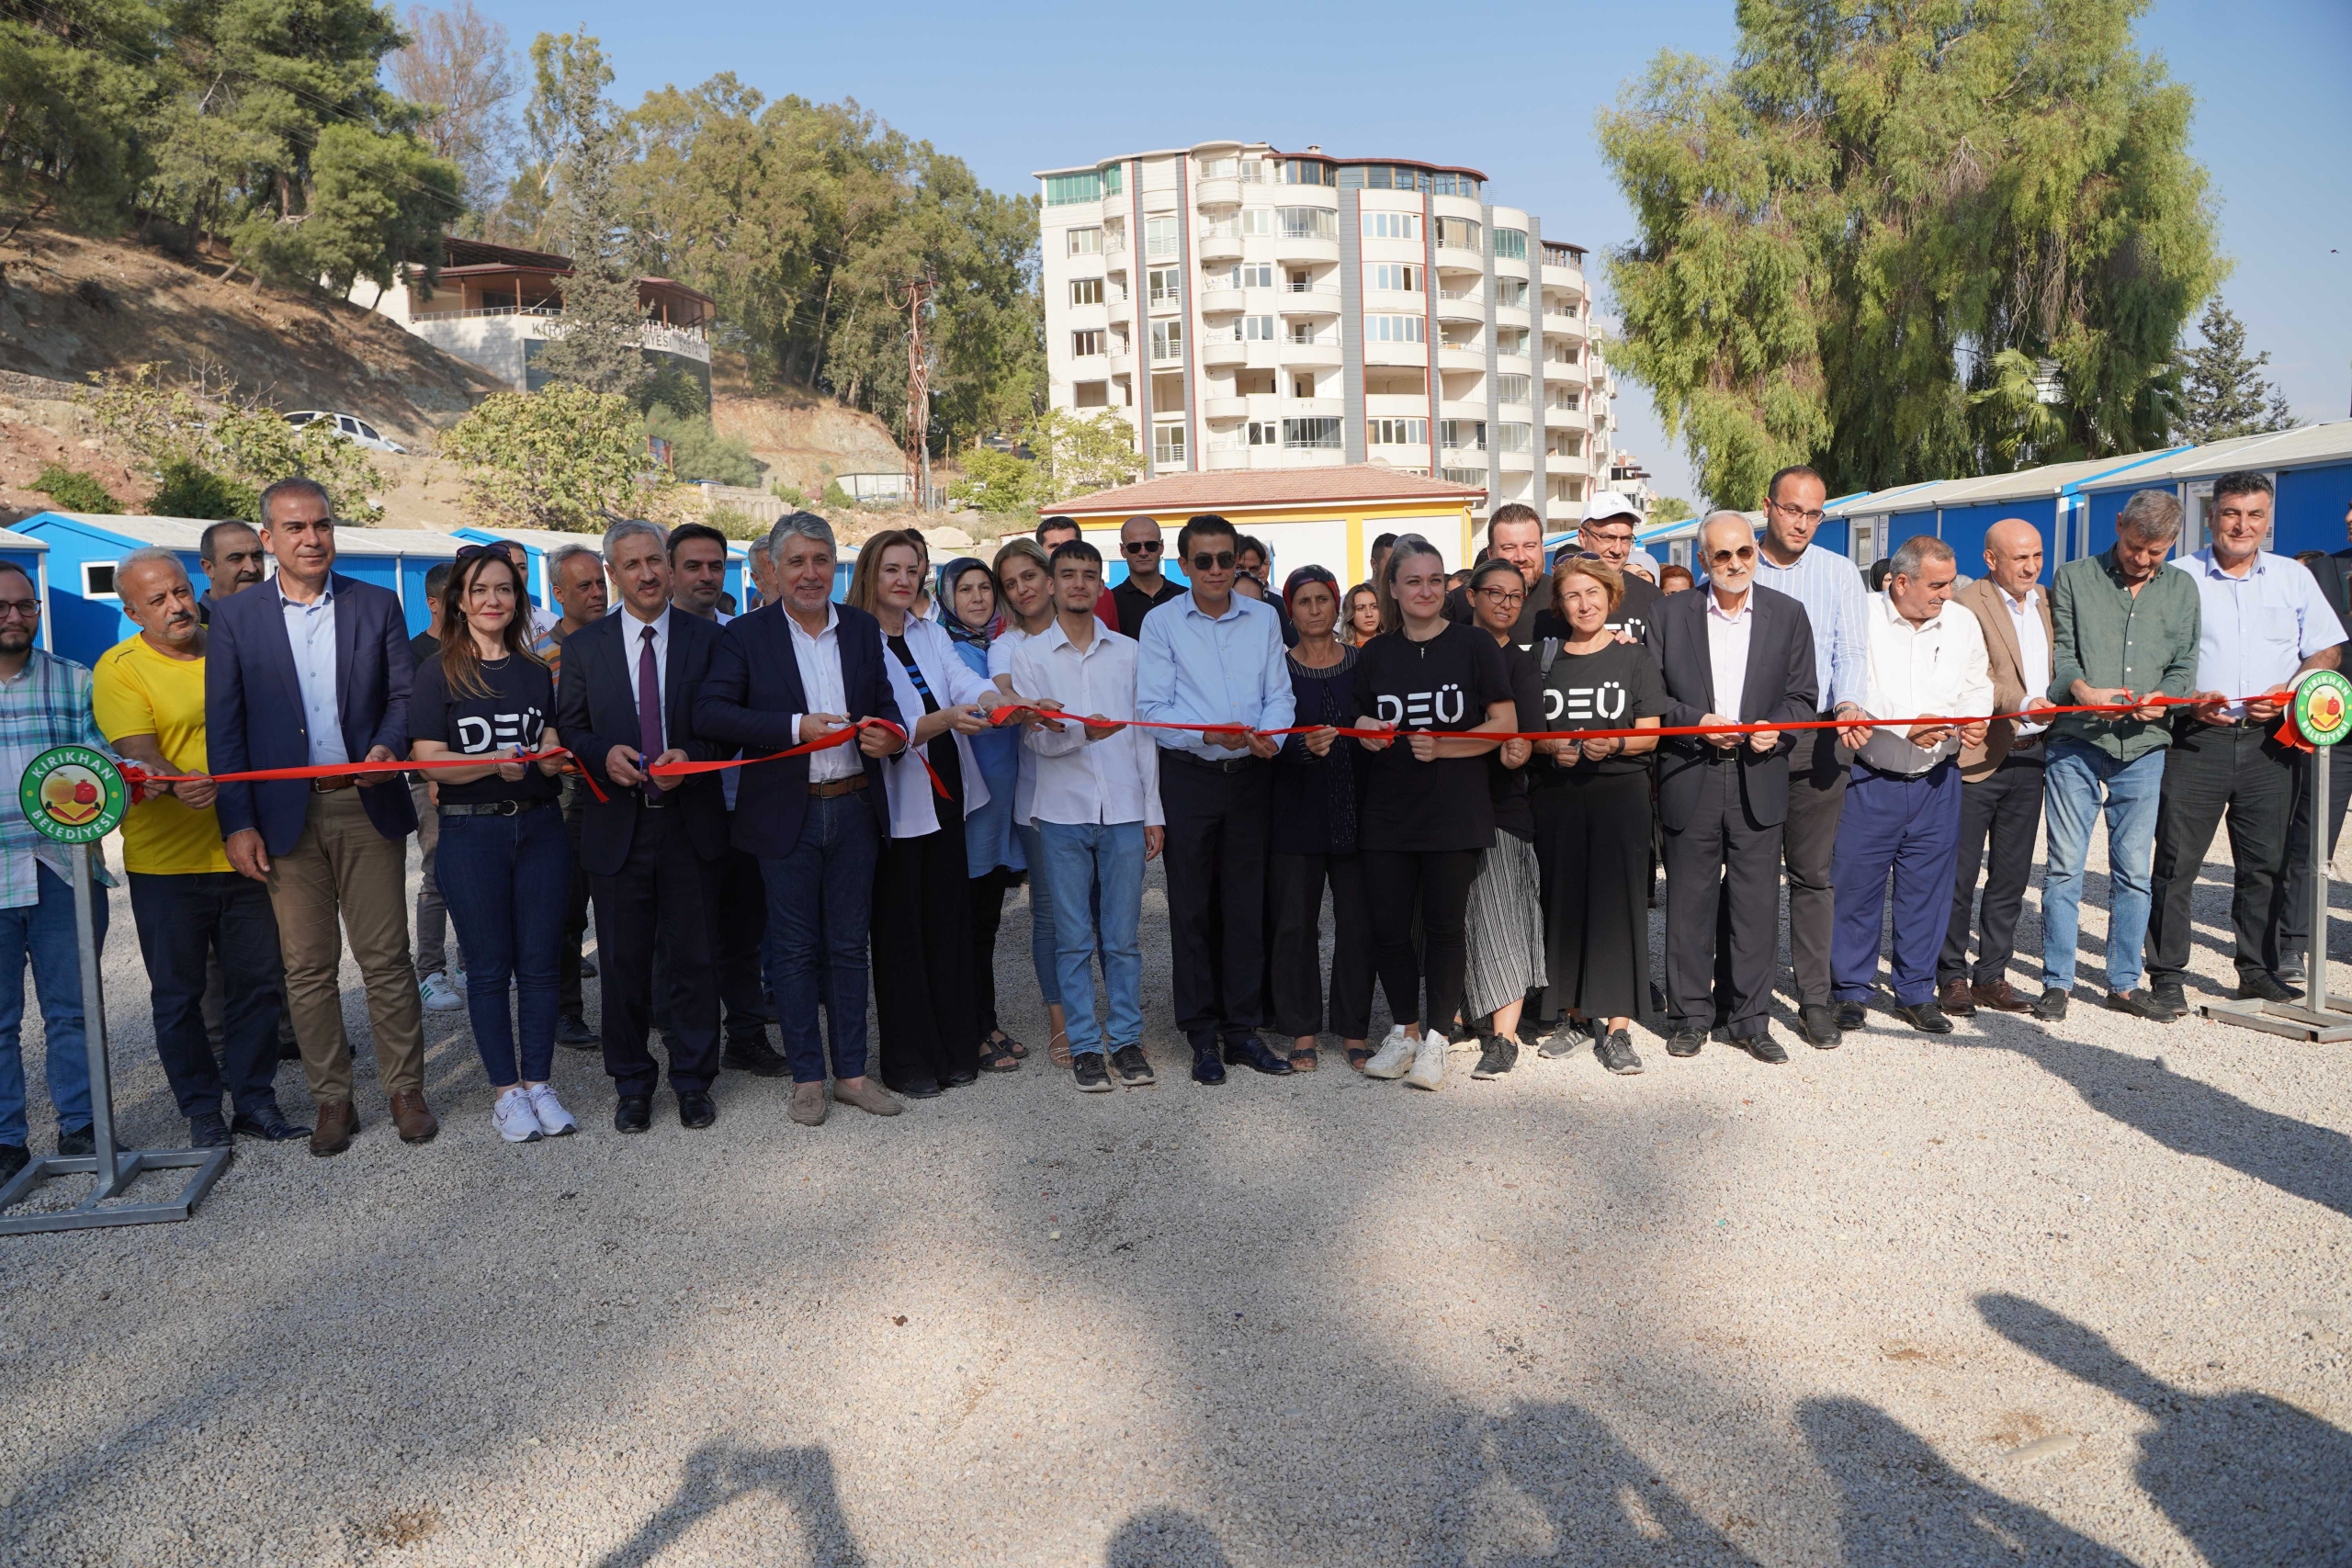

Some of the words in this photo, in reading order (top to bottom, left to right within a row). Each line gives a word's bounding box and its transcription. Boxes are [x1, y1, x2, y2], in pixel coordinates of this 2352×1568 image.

[1544, 681, 1625, 720] DEÜ
[2303, 675, 2349, 696] KIRIKHAN
[1377, 683, 1464, 726] DEÜ
[457, 706, 545, 753] DEÜ
[32, 752, 114, 780] KIRIKHAN
[31, 810, 115, 839] BELEDİYESİ
